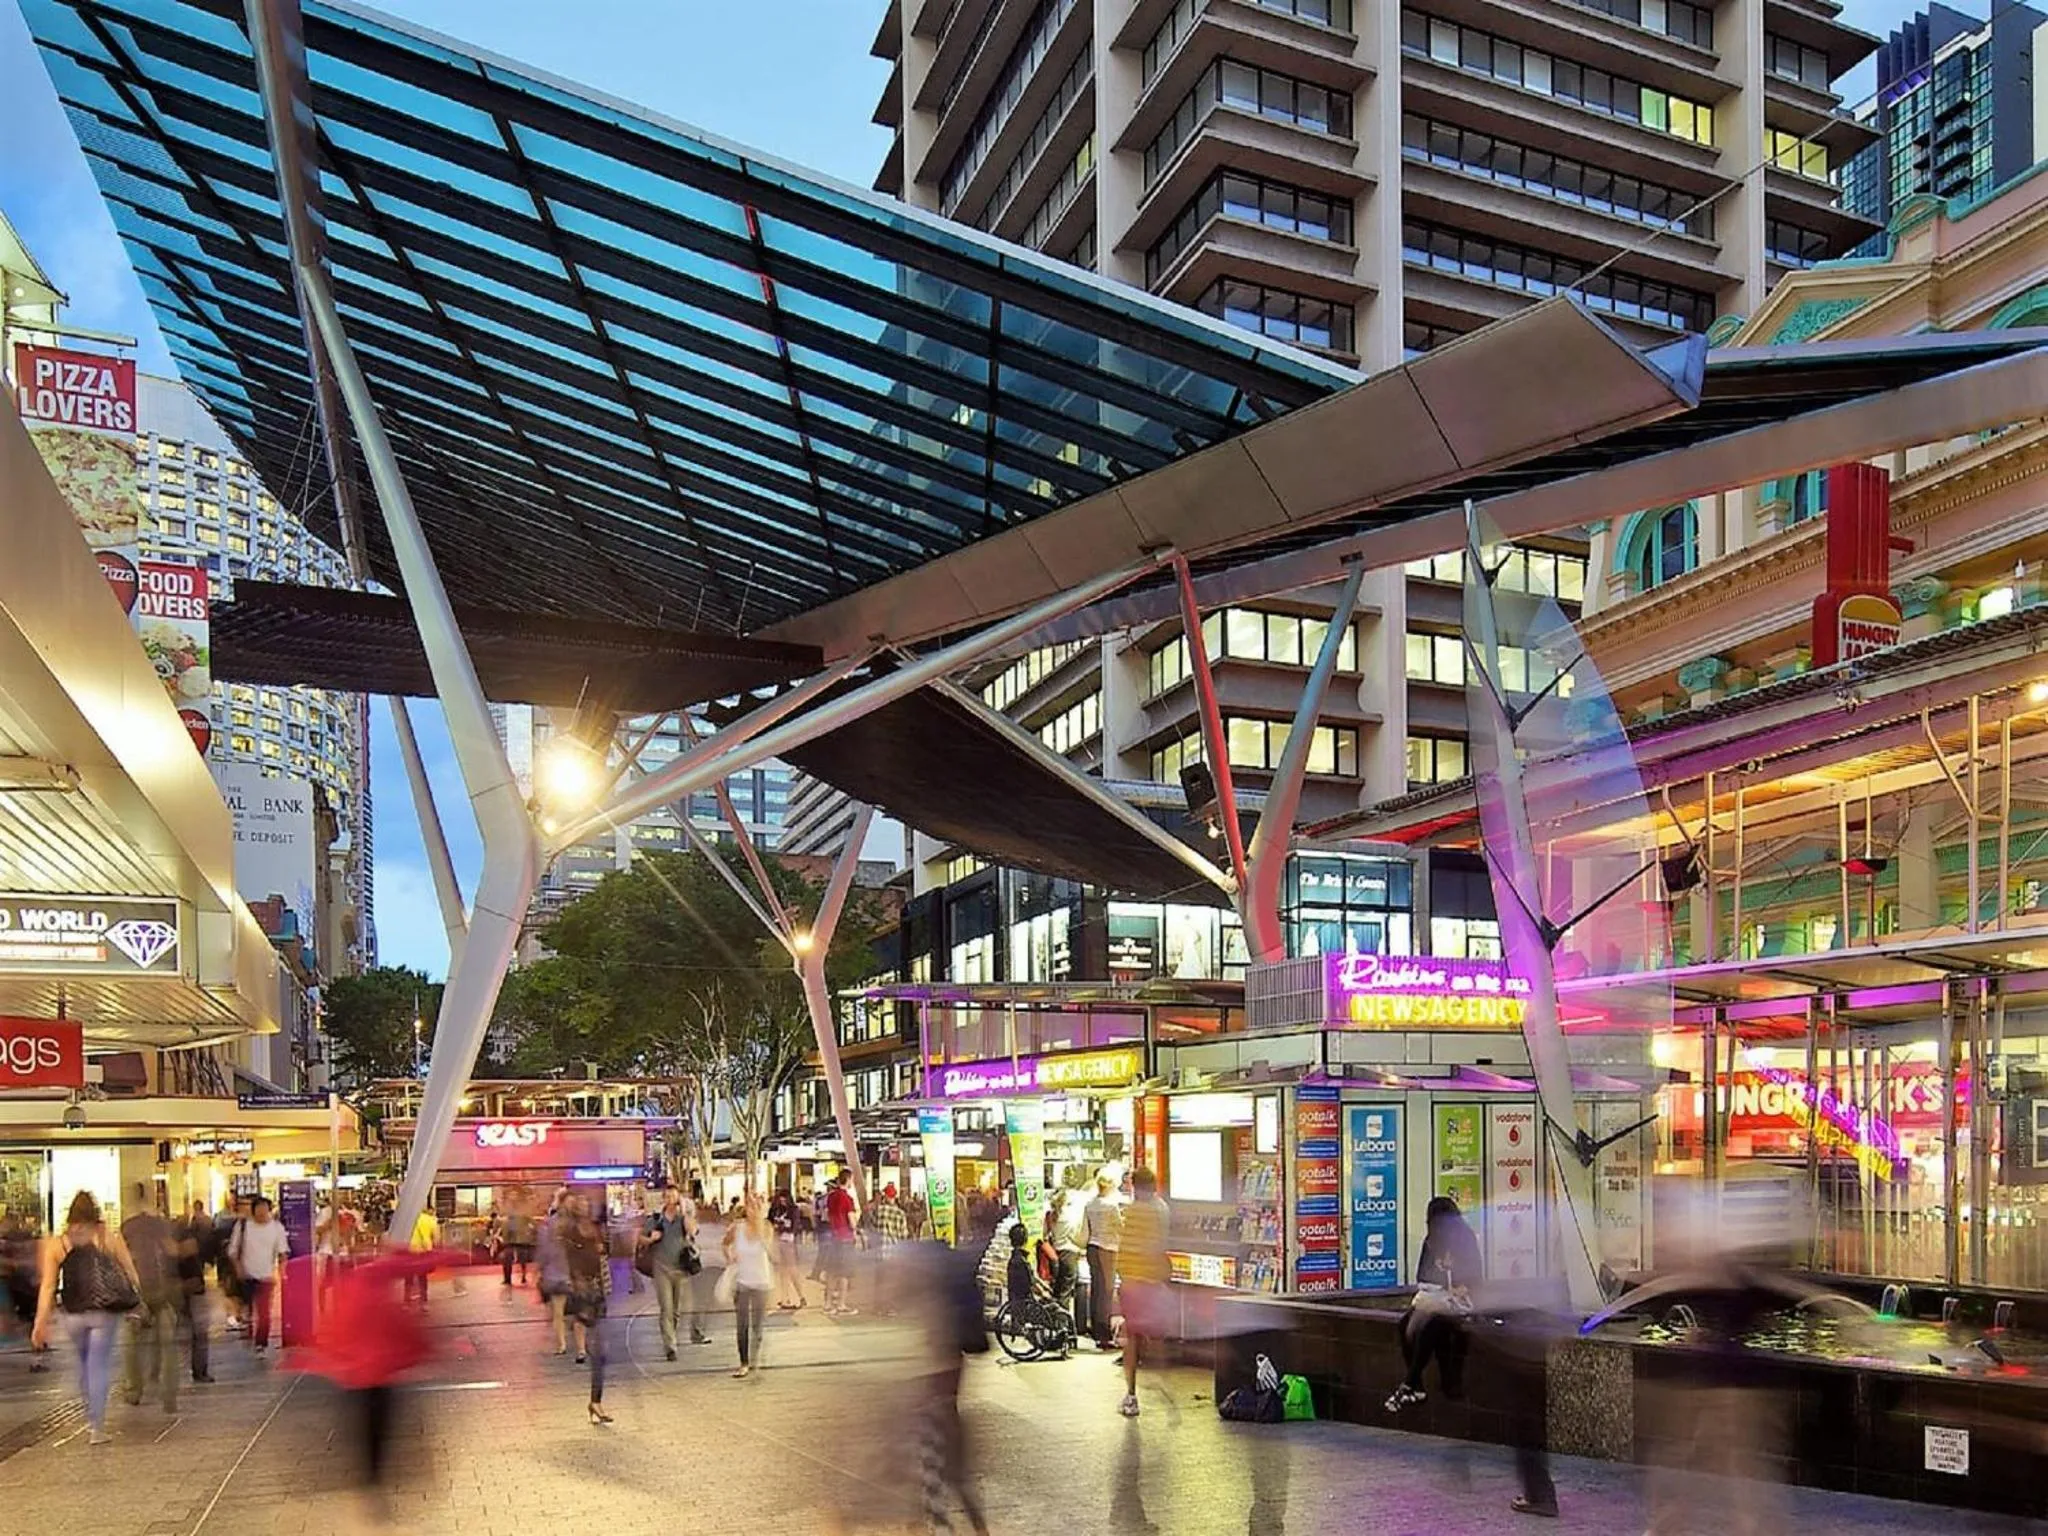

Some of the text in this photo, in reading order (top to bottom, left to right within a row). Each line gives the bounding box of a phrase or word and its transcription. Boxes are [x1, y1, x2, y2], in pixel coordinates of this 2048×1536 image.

[35, 357, 118, 398] PIZZA
[20, 387, 133, 430] LOVERS
[138, 570, 193, 596] FOOD
[1842, 621, 1900, 646] HUNGRY
[264, 798, 304, 814] BANK
[250, 832, 295, 844] DEPOSIT
[20, 908, 109, 931] WORLD
[1355, 995, 1528, 1026] NEWSAGENCY
[1036, 1053, 1130, 1085] NEWSAGENCY
[1299, 1110, 1337, 1125] gotalk
[1496, 1112, 1532, 1123] vodafone
[1354, 1139, 1395, 1152] Lebara
[1496, 1156, 1533, 1167] vodafone
[1299, 1166, 1337, 1181] gotalk
[1354, 1198, 1396, 1212] Lebara
[1299, 1222, 1338, 1239] gotalk
[1354, 1258, 1396, 1272] Lebara
